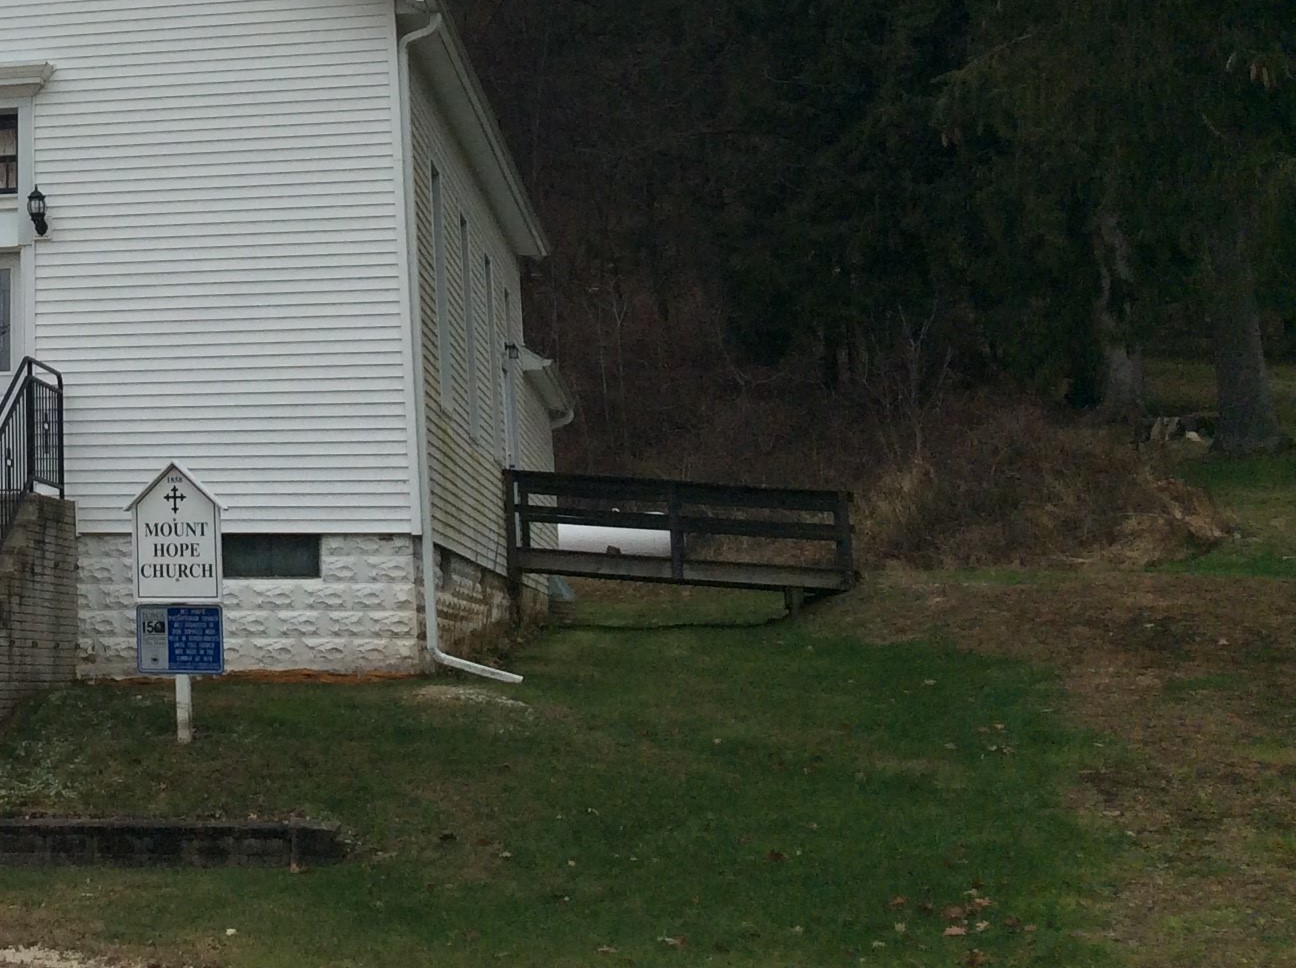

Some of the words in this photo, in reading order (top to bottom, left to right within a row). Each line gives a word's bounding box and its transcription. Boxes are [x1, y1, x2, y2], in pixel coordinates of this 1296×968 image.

[144, 522, 208, 537] MOUNT
[153, 543, 201, 557] HOPE
[140, 563, 214, 578] CHURCH
